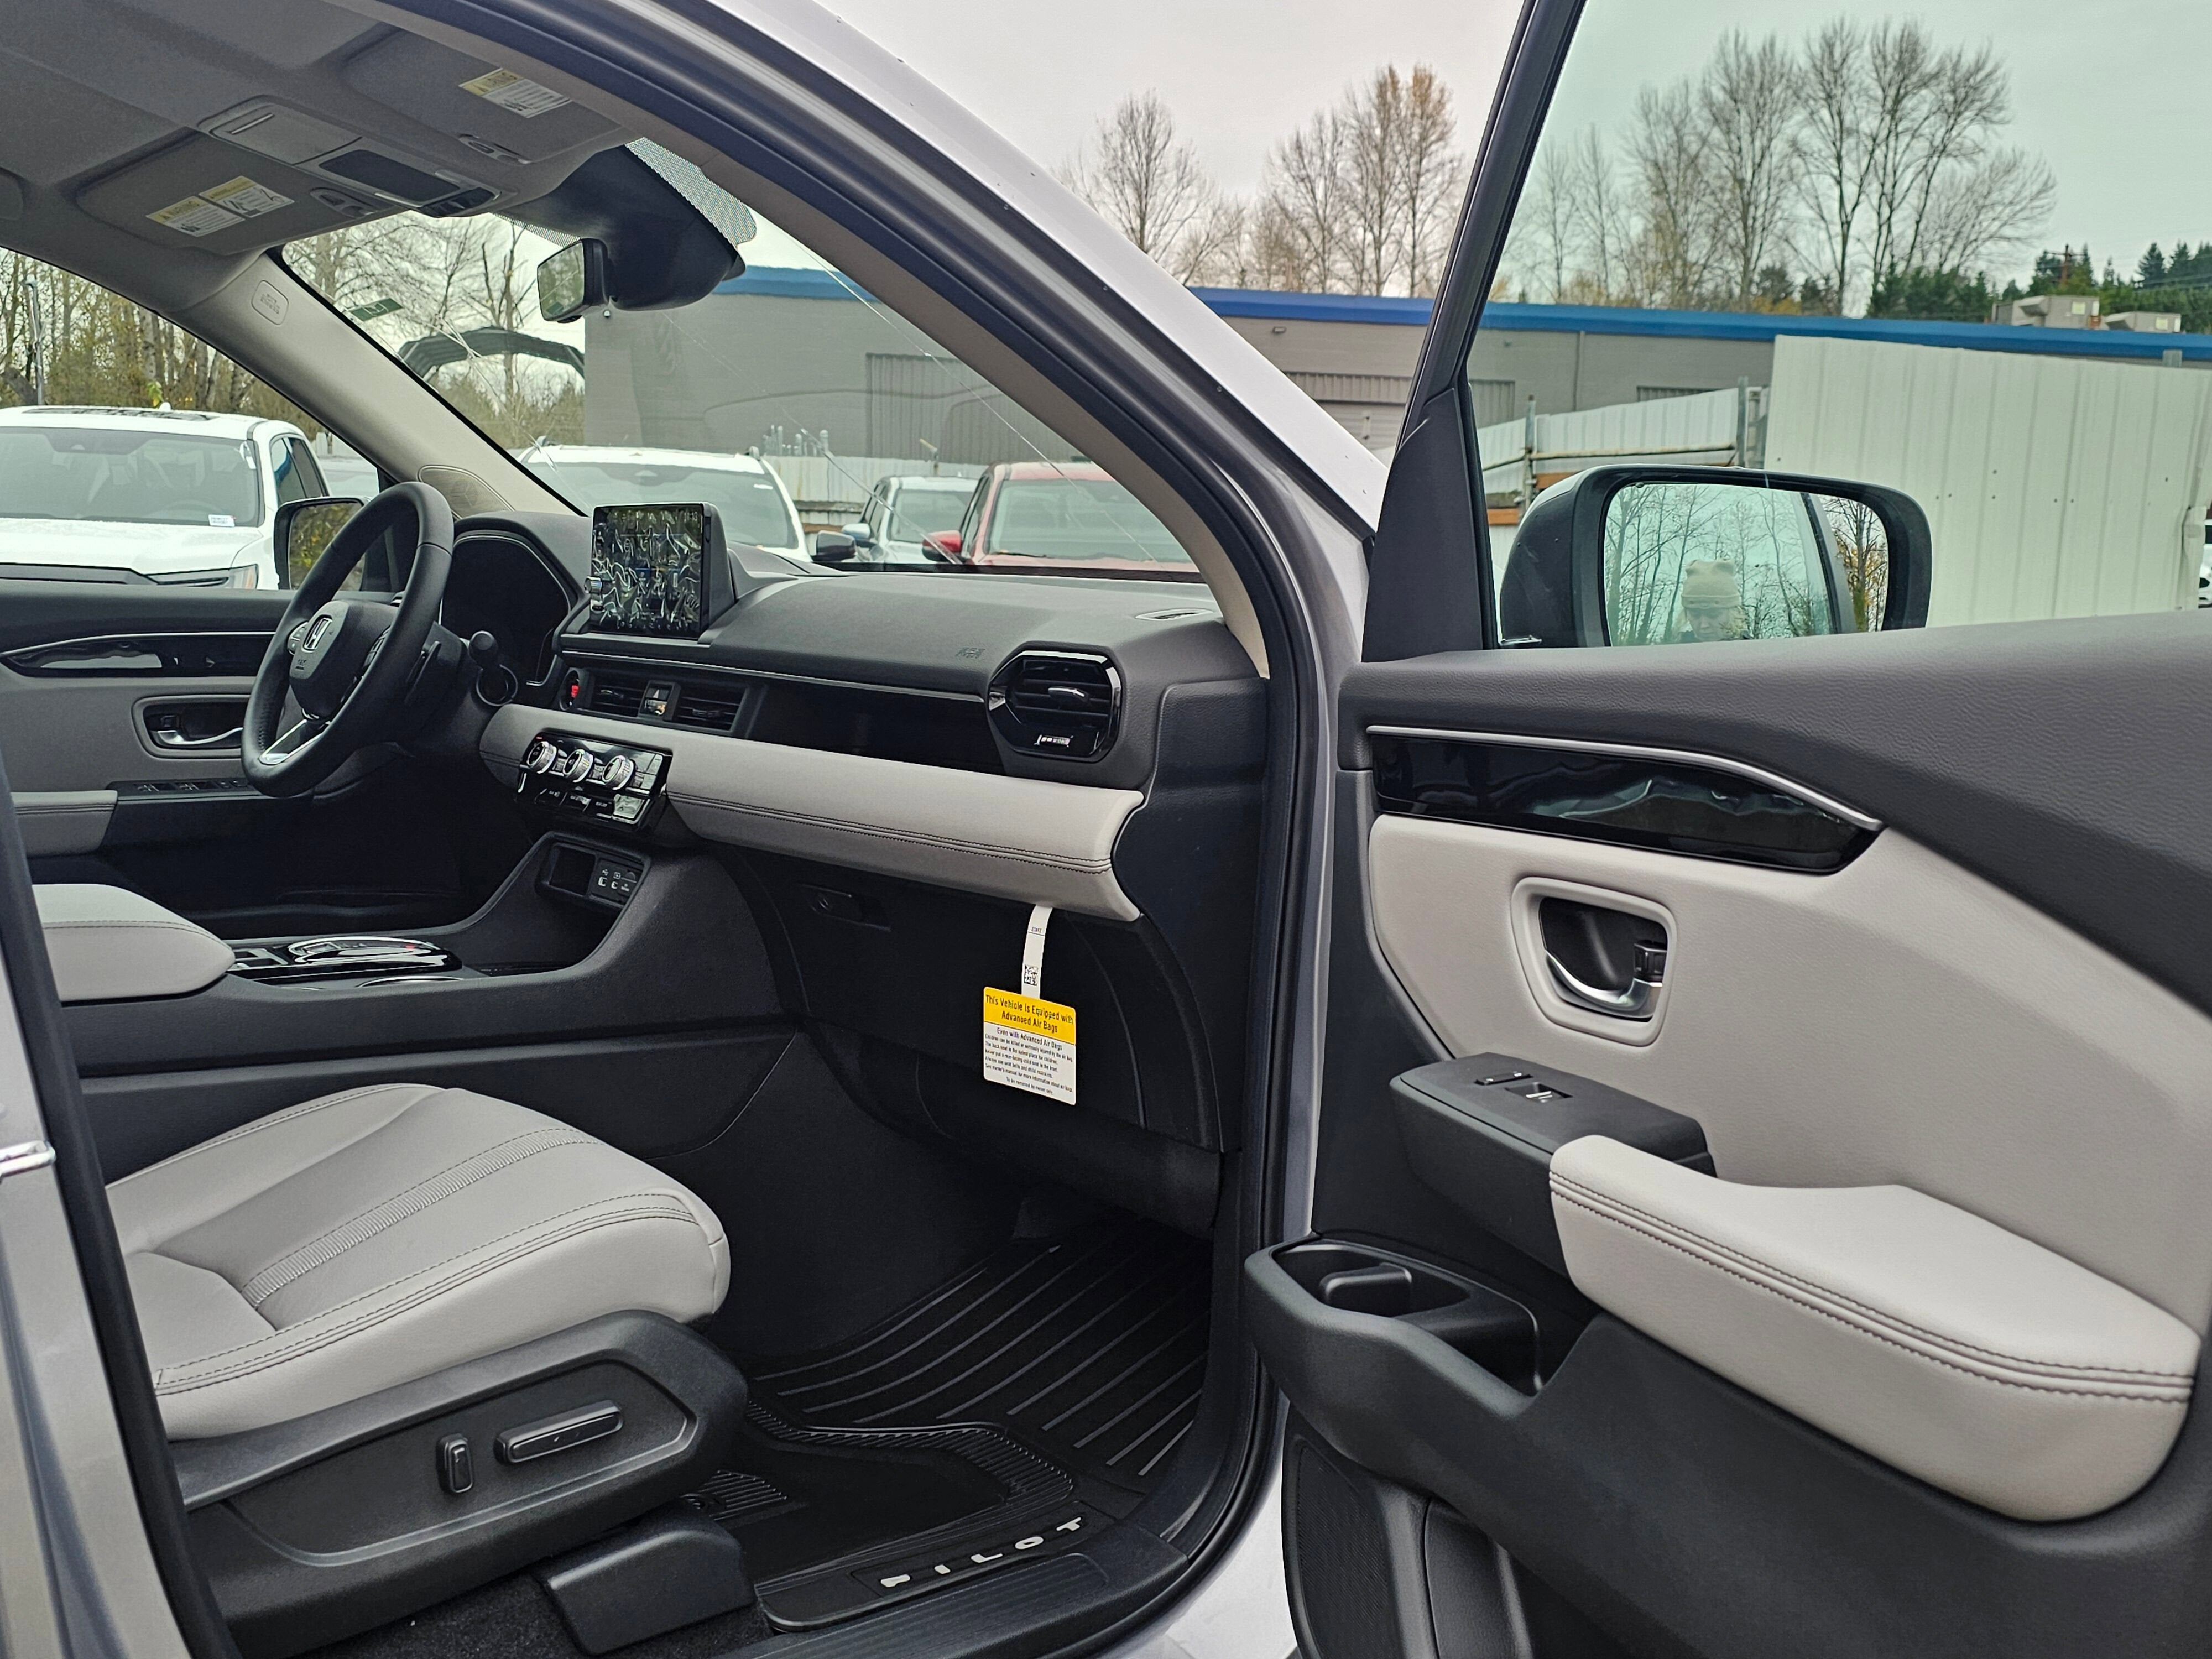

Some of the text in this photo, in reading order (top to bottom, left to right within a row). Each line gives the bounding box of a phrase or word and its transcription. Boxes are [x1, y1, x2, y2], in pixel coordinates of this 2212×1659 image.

[985, 994, 1073, 1025] This Vehicle is Equipped with
[1001, 1010, 1058, 1034] Advanced Air Bags
[880, 1517, 1082, 1587] PILOT
